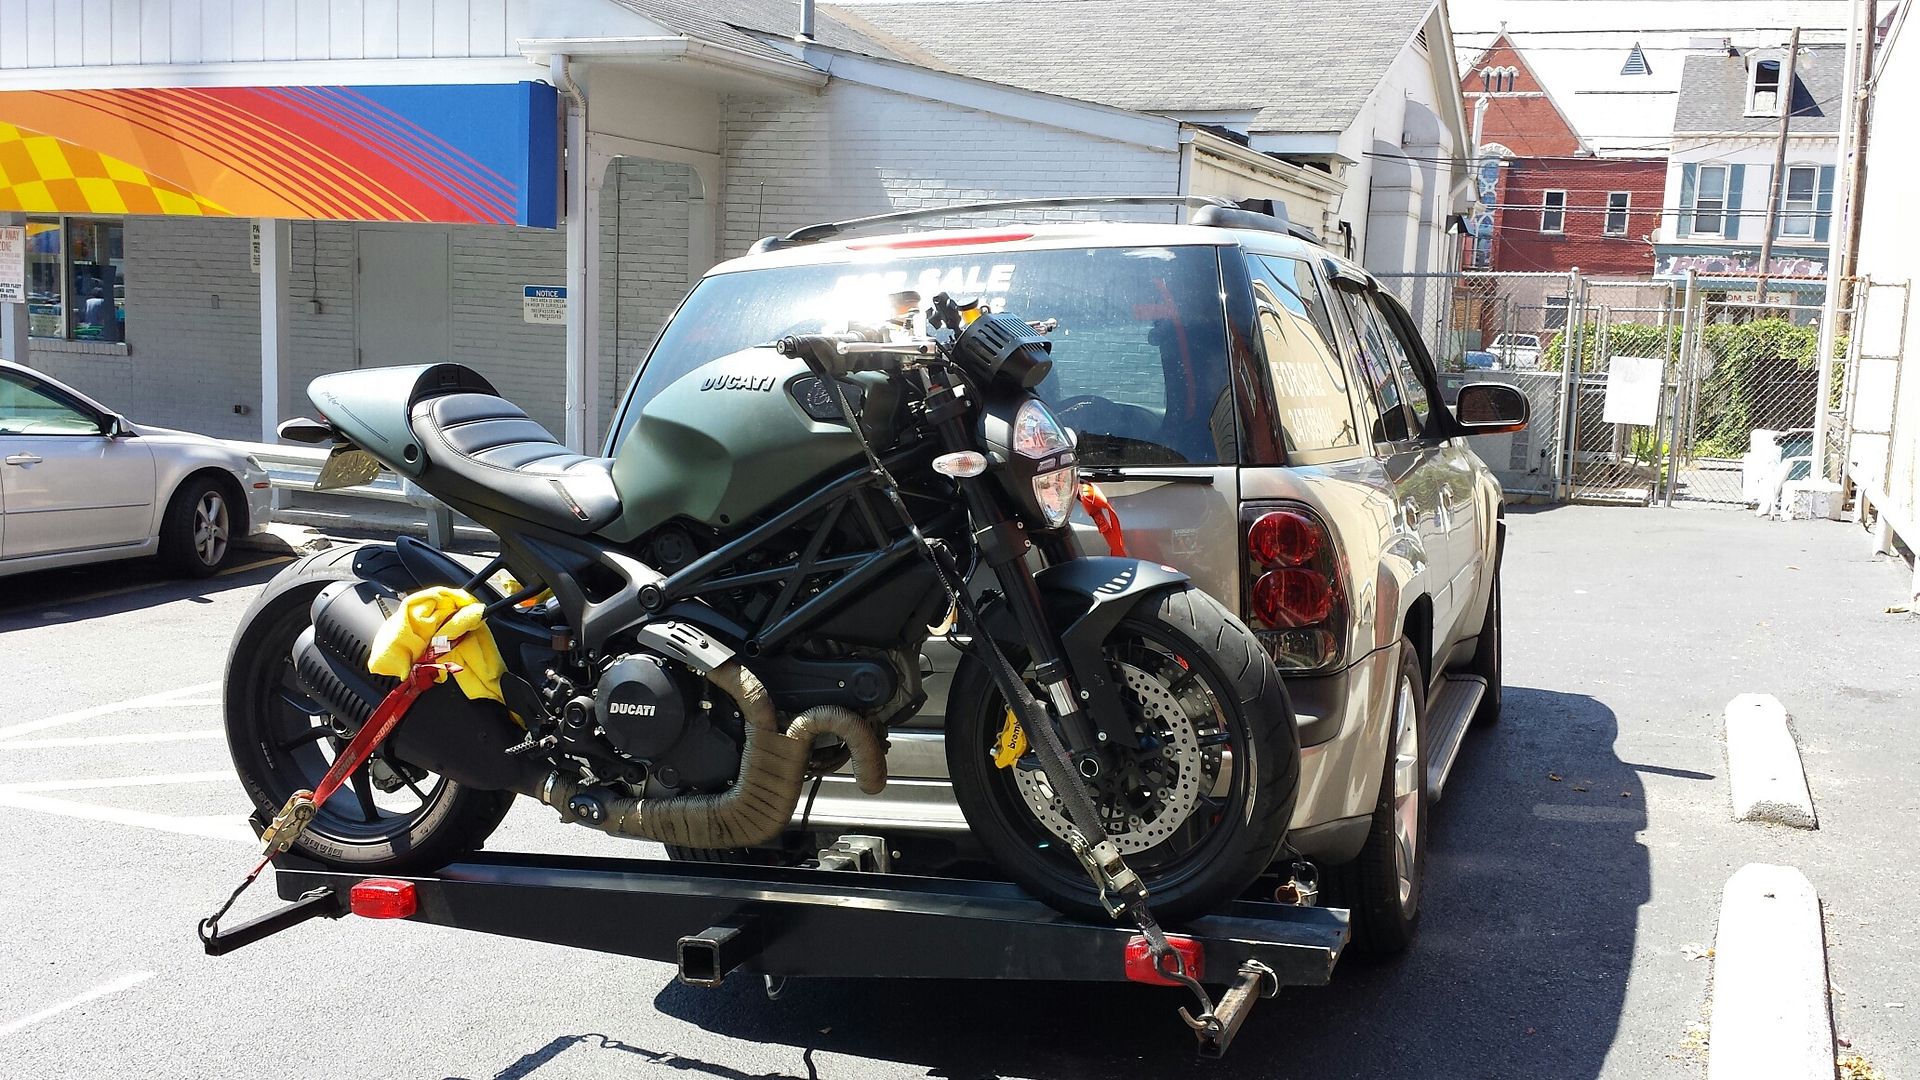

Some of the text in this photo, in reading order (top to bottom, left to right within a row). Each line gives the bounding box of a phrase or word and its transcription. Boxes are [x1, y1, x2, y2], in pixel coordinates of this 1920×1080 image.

[918, 264, 1016, 294] SALE
[536, 289, 559, 298] NOTICE
[700, 375, 777, 393] DUCATI
[1271, 361, 1327, 397] FOR SALE
[609, 702, 656, 717] DUCATI
